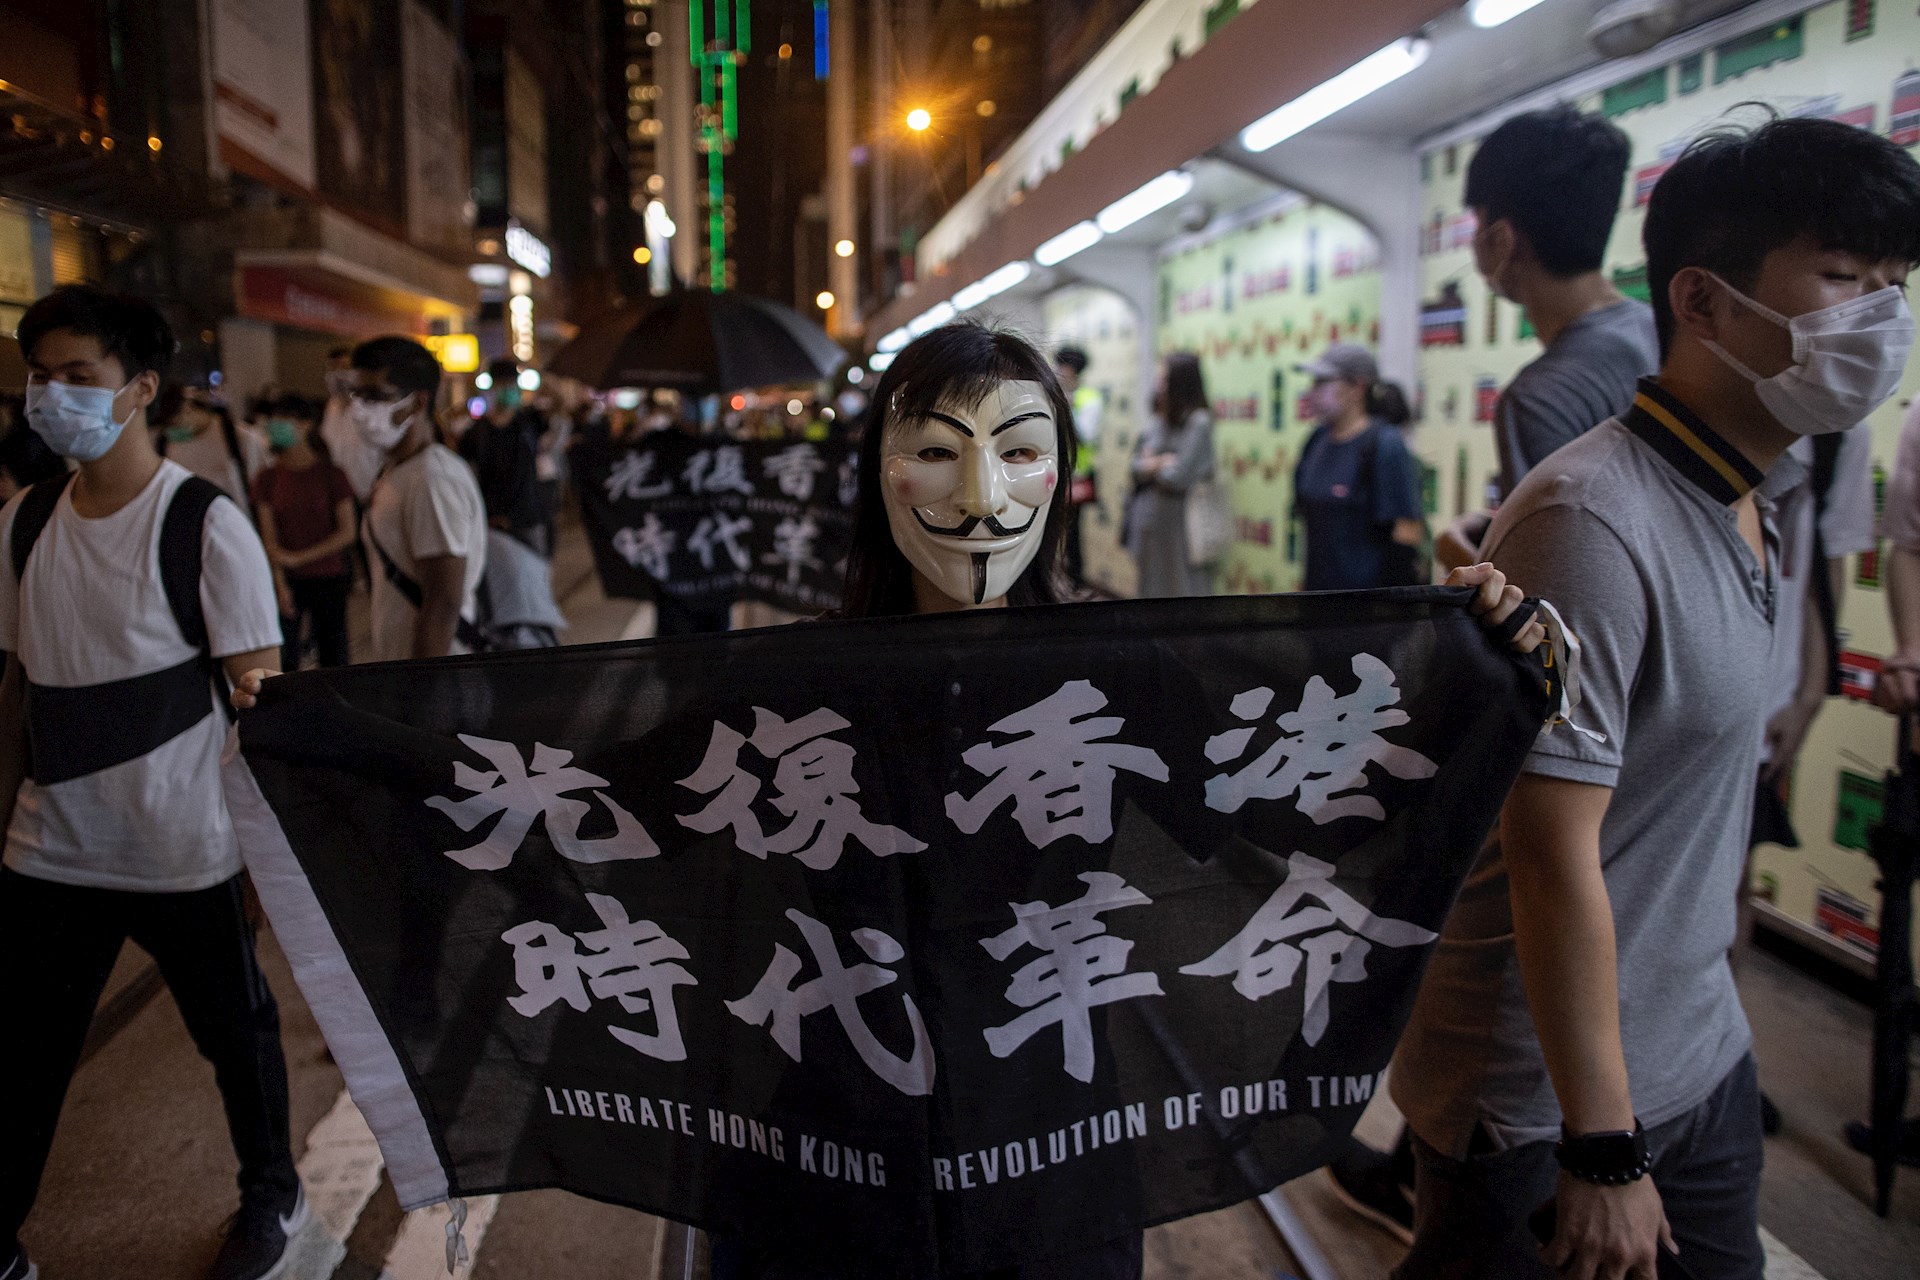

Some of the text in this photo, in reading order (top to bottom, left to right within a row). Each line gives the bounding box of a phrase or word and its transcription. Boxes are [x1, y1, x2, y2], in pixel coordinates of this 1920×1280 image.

[424, 652, 1438, 871] 光復香港
[501, 851, 1438, 1095] 時代革命
[545, 1086, 695, 1136] LIBERATE
[708, 1108, 785, 1162] HONG
[800, 1134, 887, 1187] KONG
[933, 1102, 1147, 1191] REVOLUTION
[1163, 1092, 1202, 1130] OF
[1220, 1079, 1287, 1119] OUR
